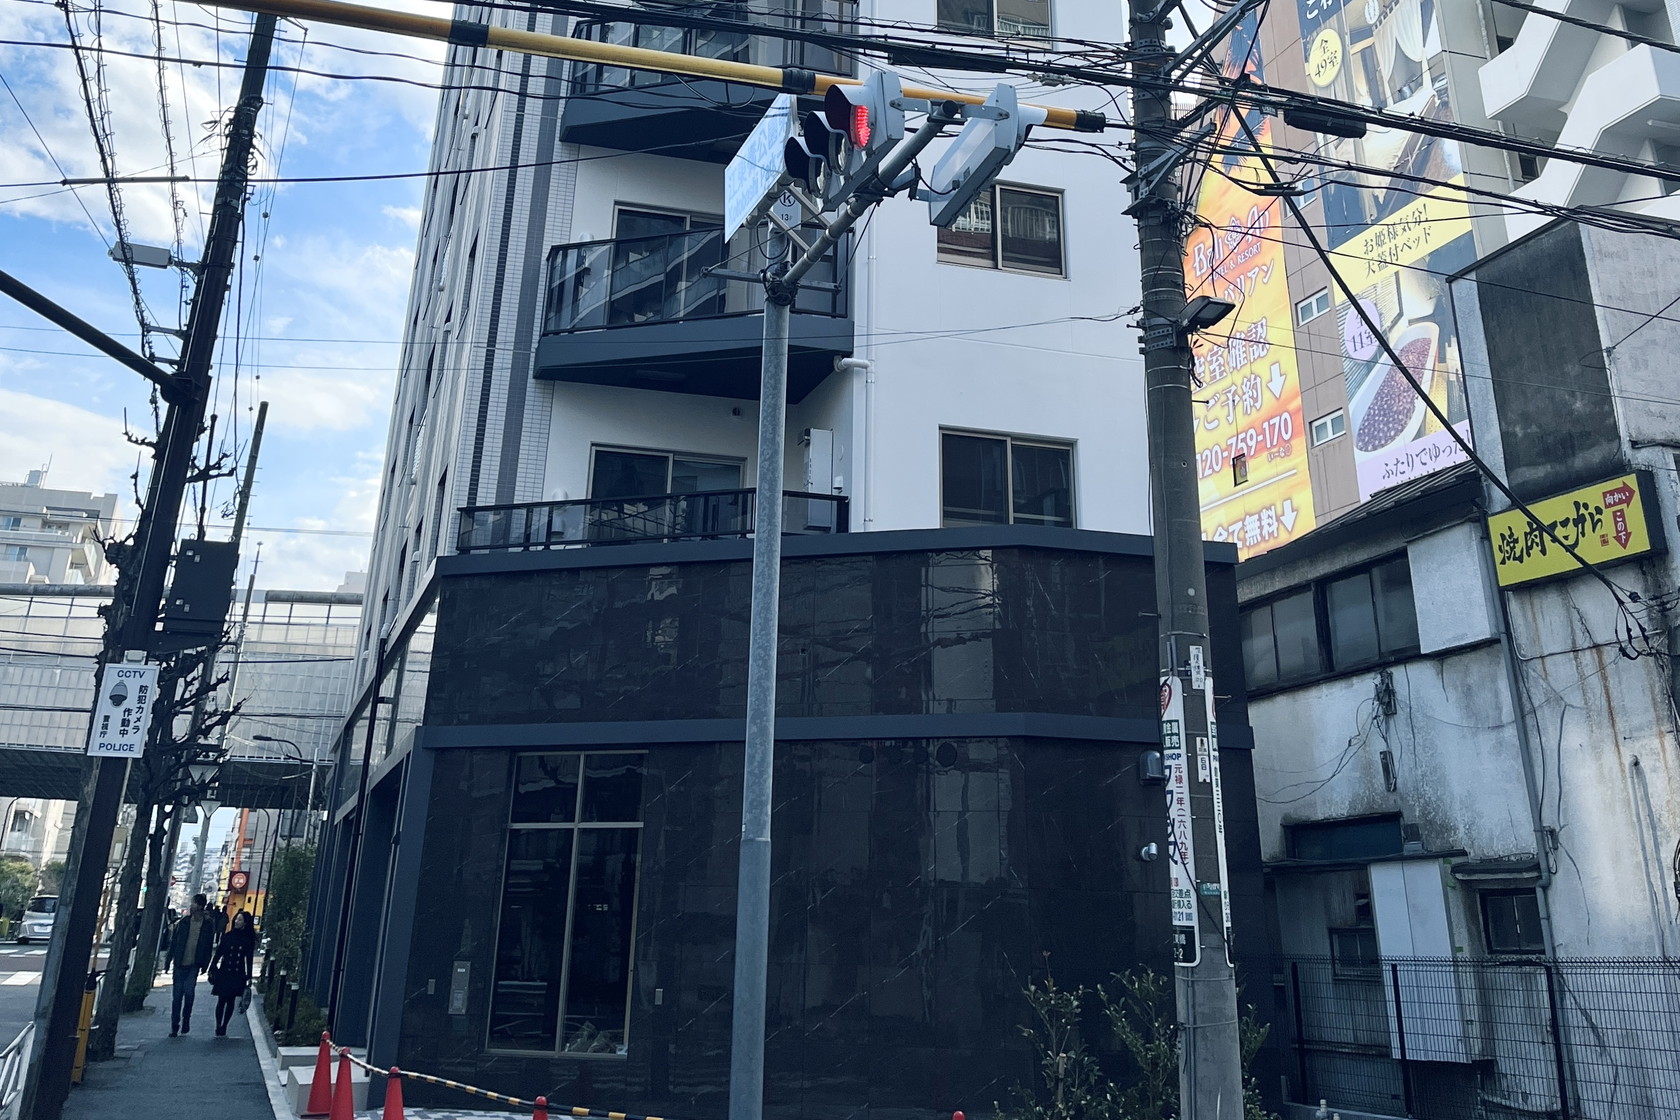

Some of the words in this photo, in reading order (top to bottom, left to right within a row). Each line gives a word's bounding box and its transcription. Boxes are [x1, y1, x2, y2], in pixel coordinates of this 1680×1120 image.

[1237, 242, 1262, 264] RESORT
[1616, 512, 1626, 544] この下
[117, 669, 146, 679] CCTV
[132, 684, 149, 735] 防犯カメラ
[99, 714, 111, 739] 警視庁
[119, 707, 133, 738] 作動中
[98, 742, 135, 752] POLICE
